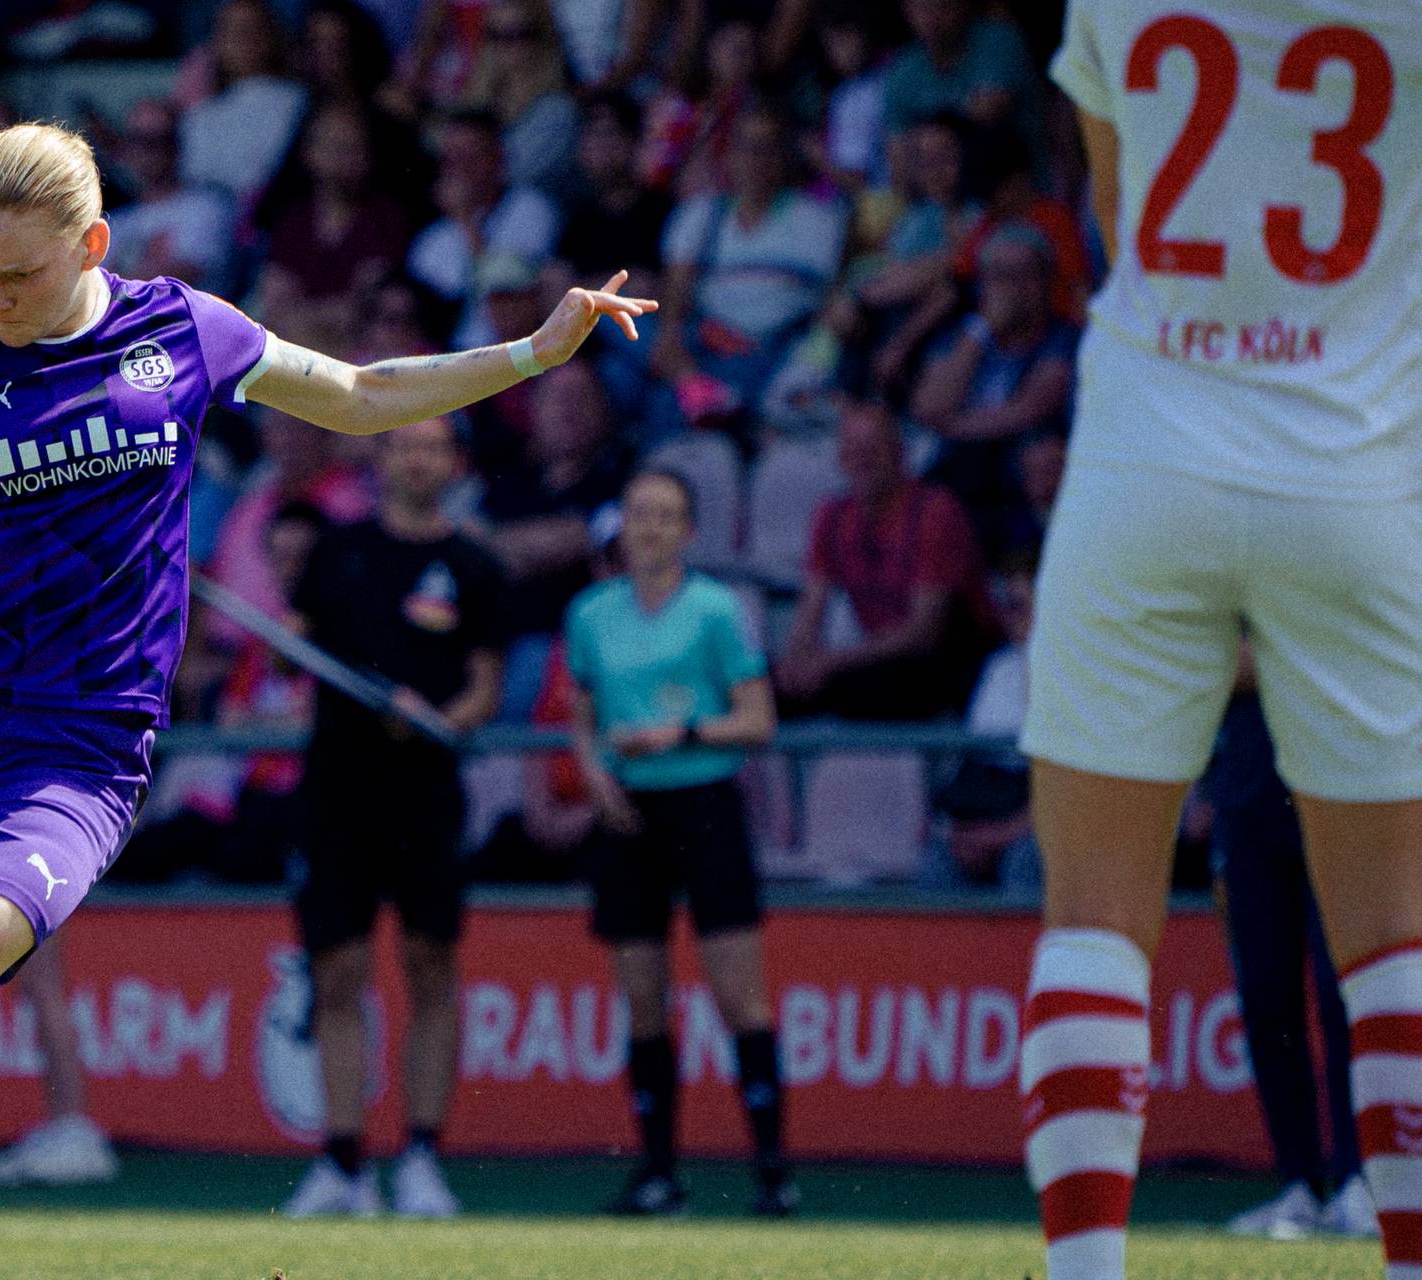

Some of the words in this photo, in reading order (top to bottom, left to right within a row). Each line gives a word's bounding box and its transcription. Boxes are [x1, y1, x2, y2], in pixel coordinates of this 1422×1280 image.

[1125, 12, 1395, 286] 23
[131, 359, 164, 378] SGS
[135, 348, 154, 358] ESSEN
[1, 446, 177, 496] WOHNKOMPANIE
